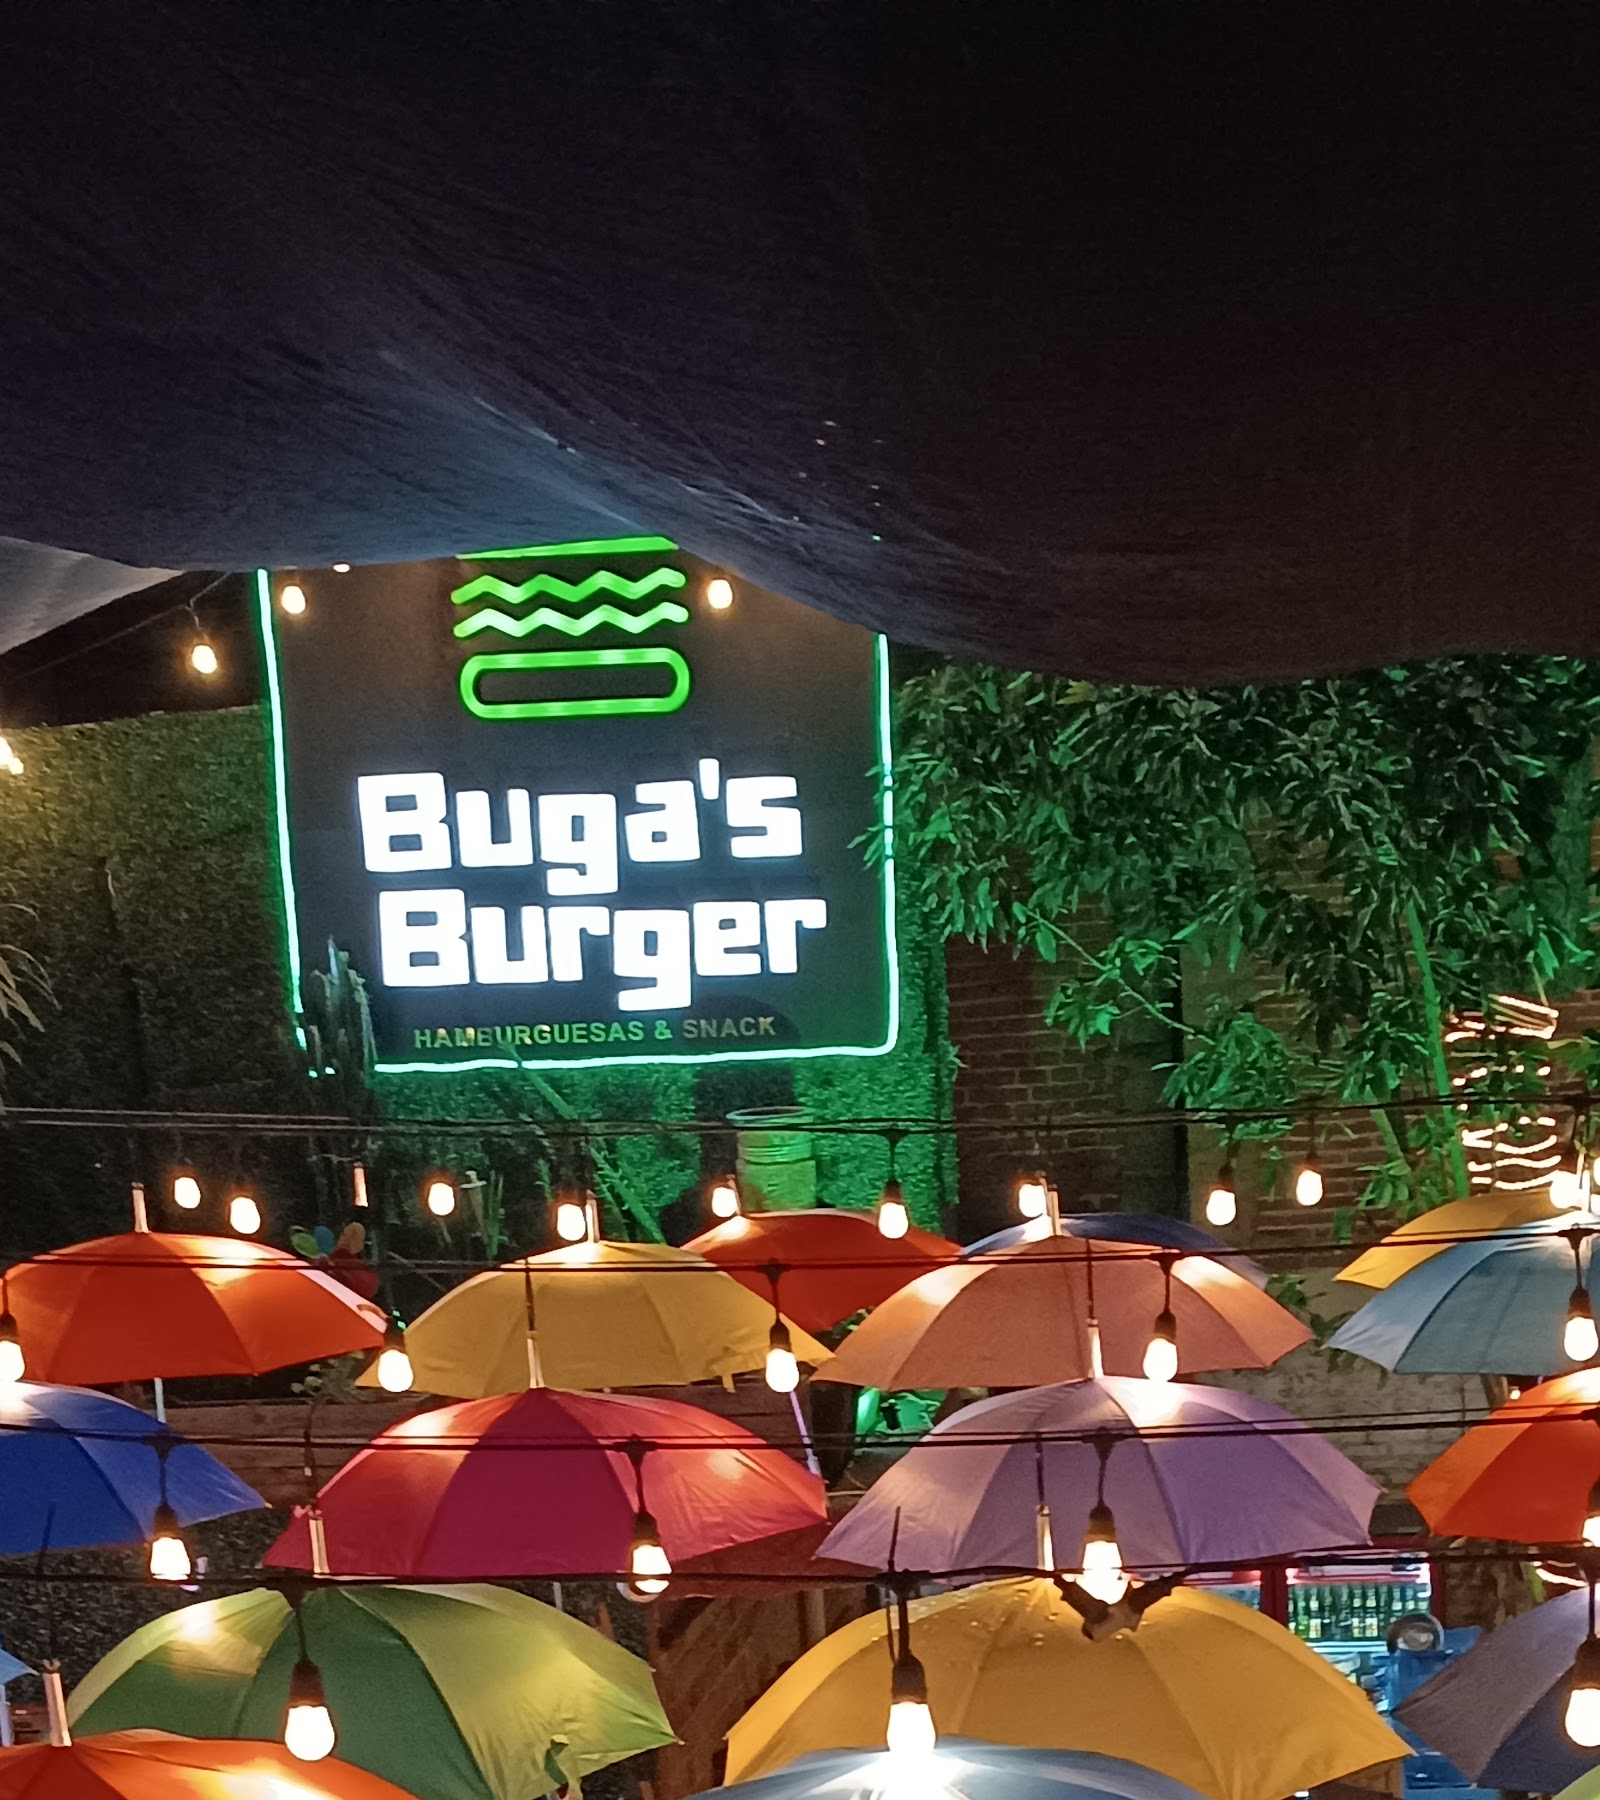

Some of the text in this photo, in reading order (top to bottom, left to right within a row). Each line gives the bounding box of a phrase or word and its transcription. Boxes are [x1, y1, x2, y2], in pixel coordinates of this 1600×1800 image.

[356, 757, 803, 897] Buga's
[378, 888, 828, 1011] Burger
[413, 1015, 777, 1050] HAMBURGUESAS & SNACK
